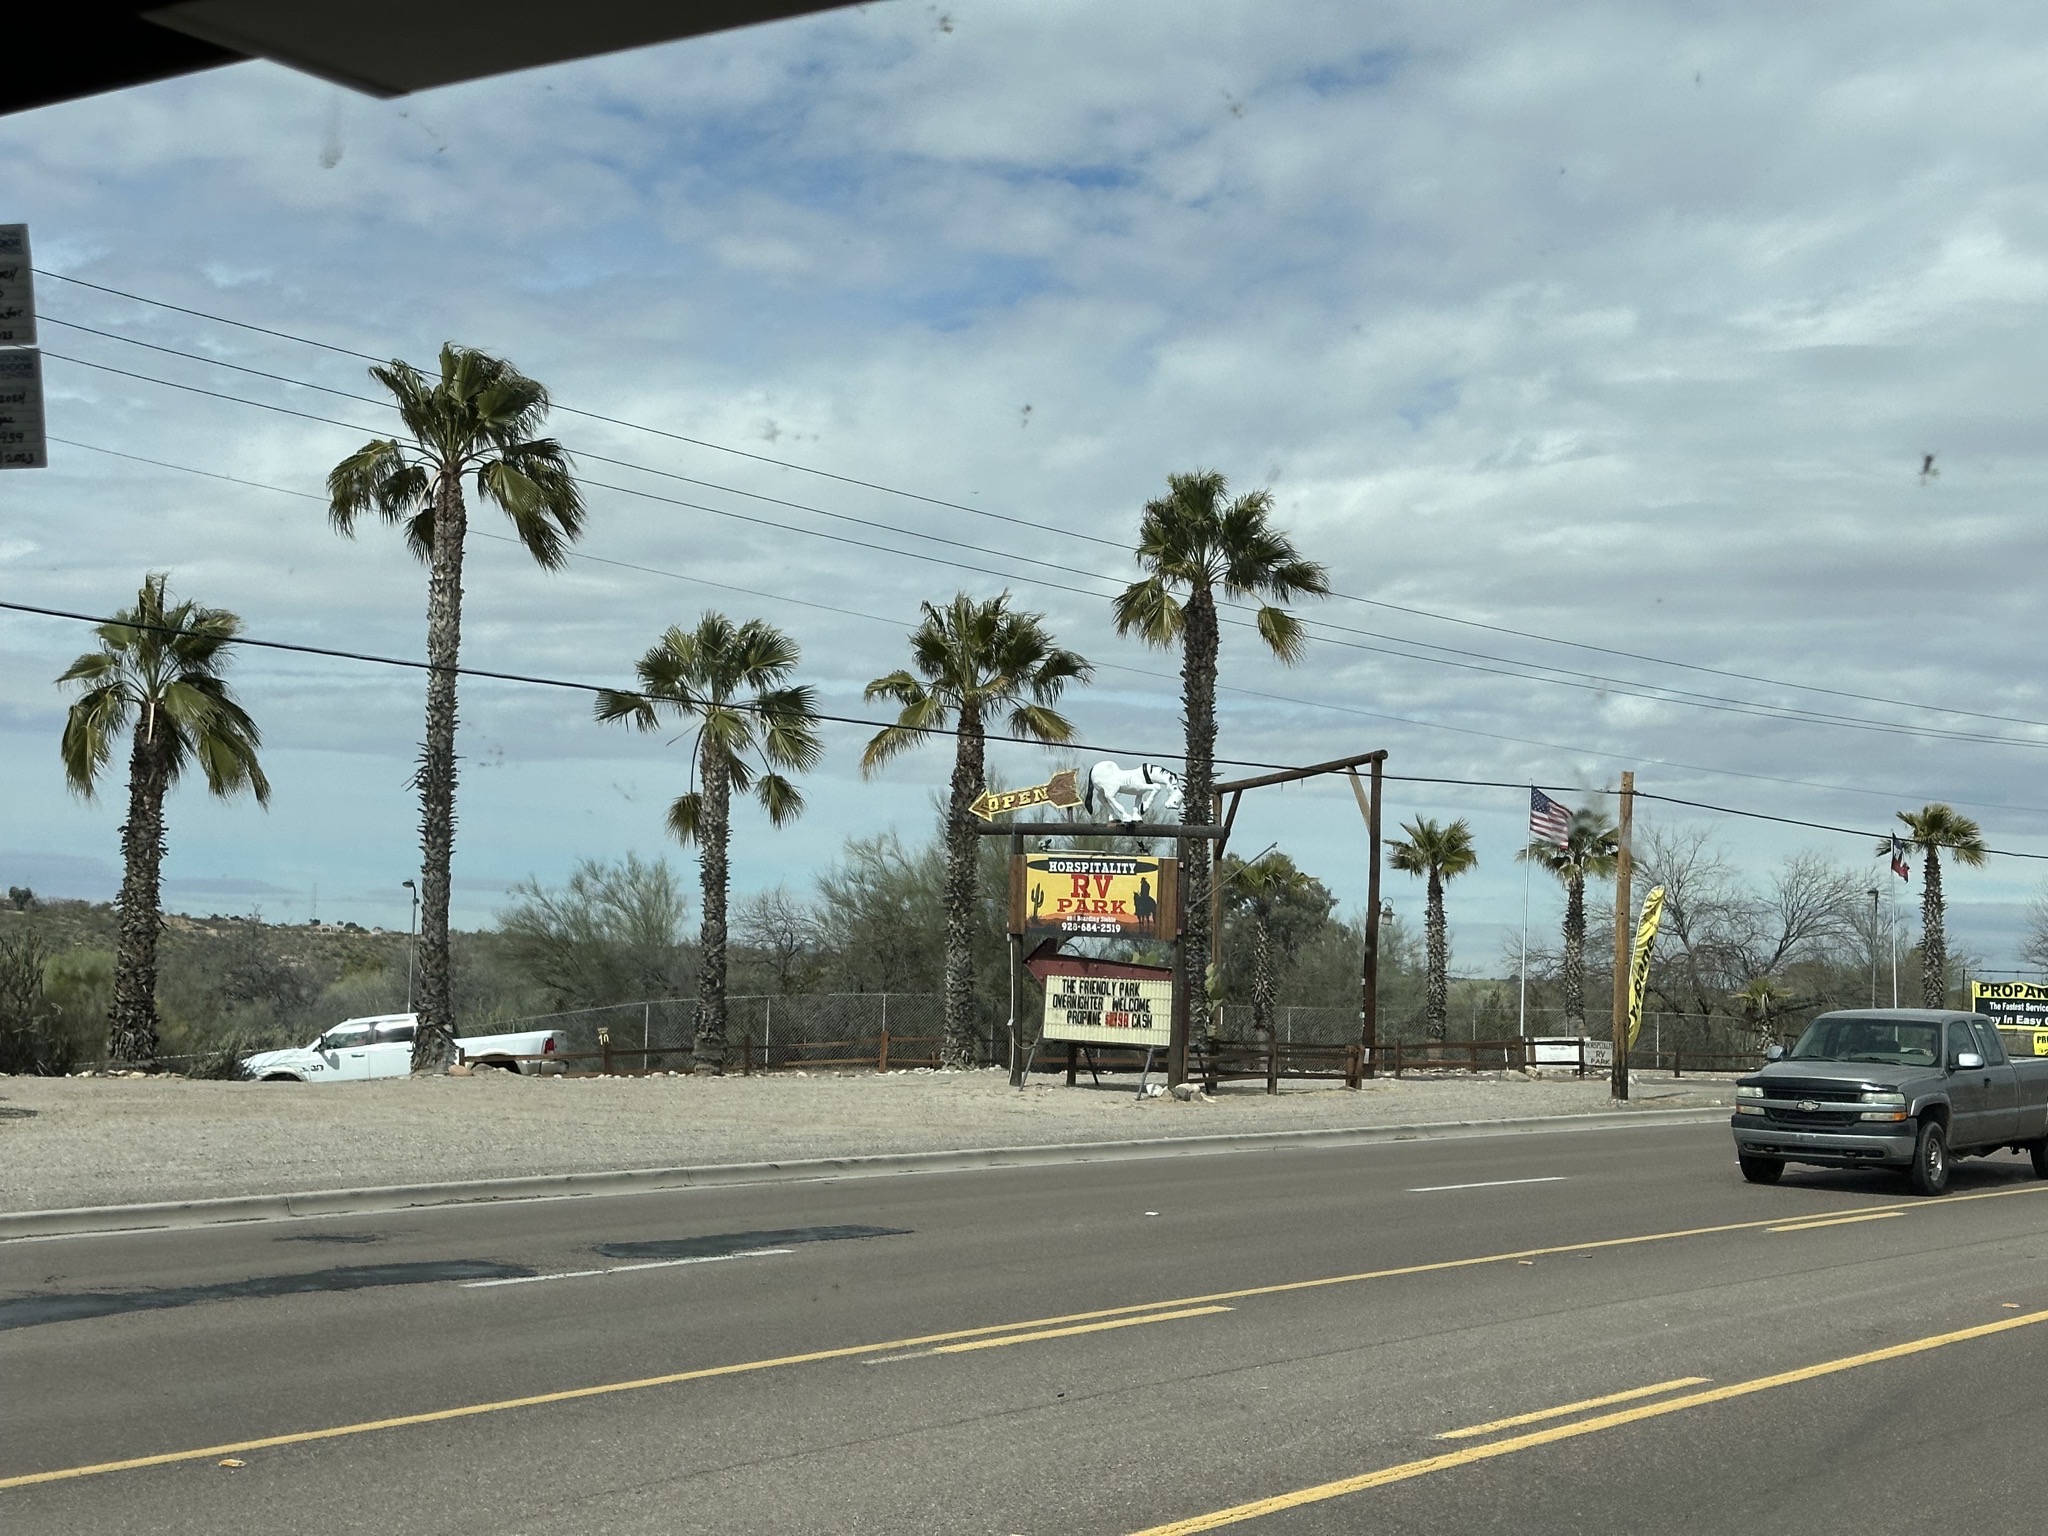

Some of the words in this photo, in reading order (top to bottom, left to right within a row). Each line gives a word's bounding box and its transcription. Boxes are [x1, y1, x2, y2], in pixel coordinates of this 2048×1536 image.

[988, 786, 1049, 812] OPEN
[1048, 861, 1137, 874] HORSPITALITY
[1070, 873, 1114, 899] RV
[1056, 898, 1127, 915] PARK
[1061, 922, 1121, 933] 928-684-2519
[1062, 979, 1076, 994] THE
[1079, 980, 1117, 996] FRIENDLY
[1119, 982, 1141, 997] PARK
[1052, 994, 1104, 1011] OVERNIGHTER
[1112, 998, 1151, 1013] WELCOME
[1989, 1001, 2001, 1010] The
[2002, 1002, 2024, 1011] Fastest
[1066, 1010, 1102, 1026] PROPANE
[1131, 1013, 1153, 1029] CASH
[2003, 1014, 2013, 1024] In
[2016, 1015, 2042, 1027] Easy
[1595, 1050, 1606, 1059] RV
